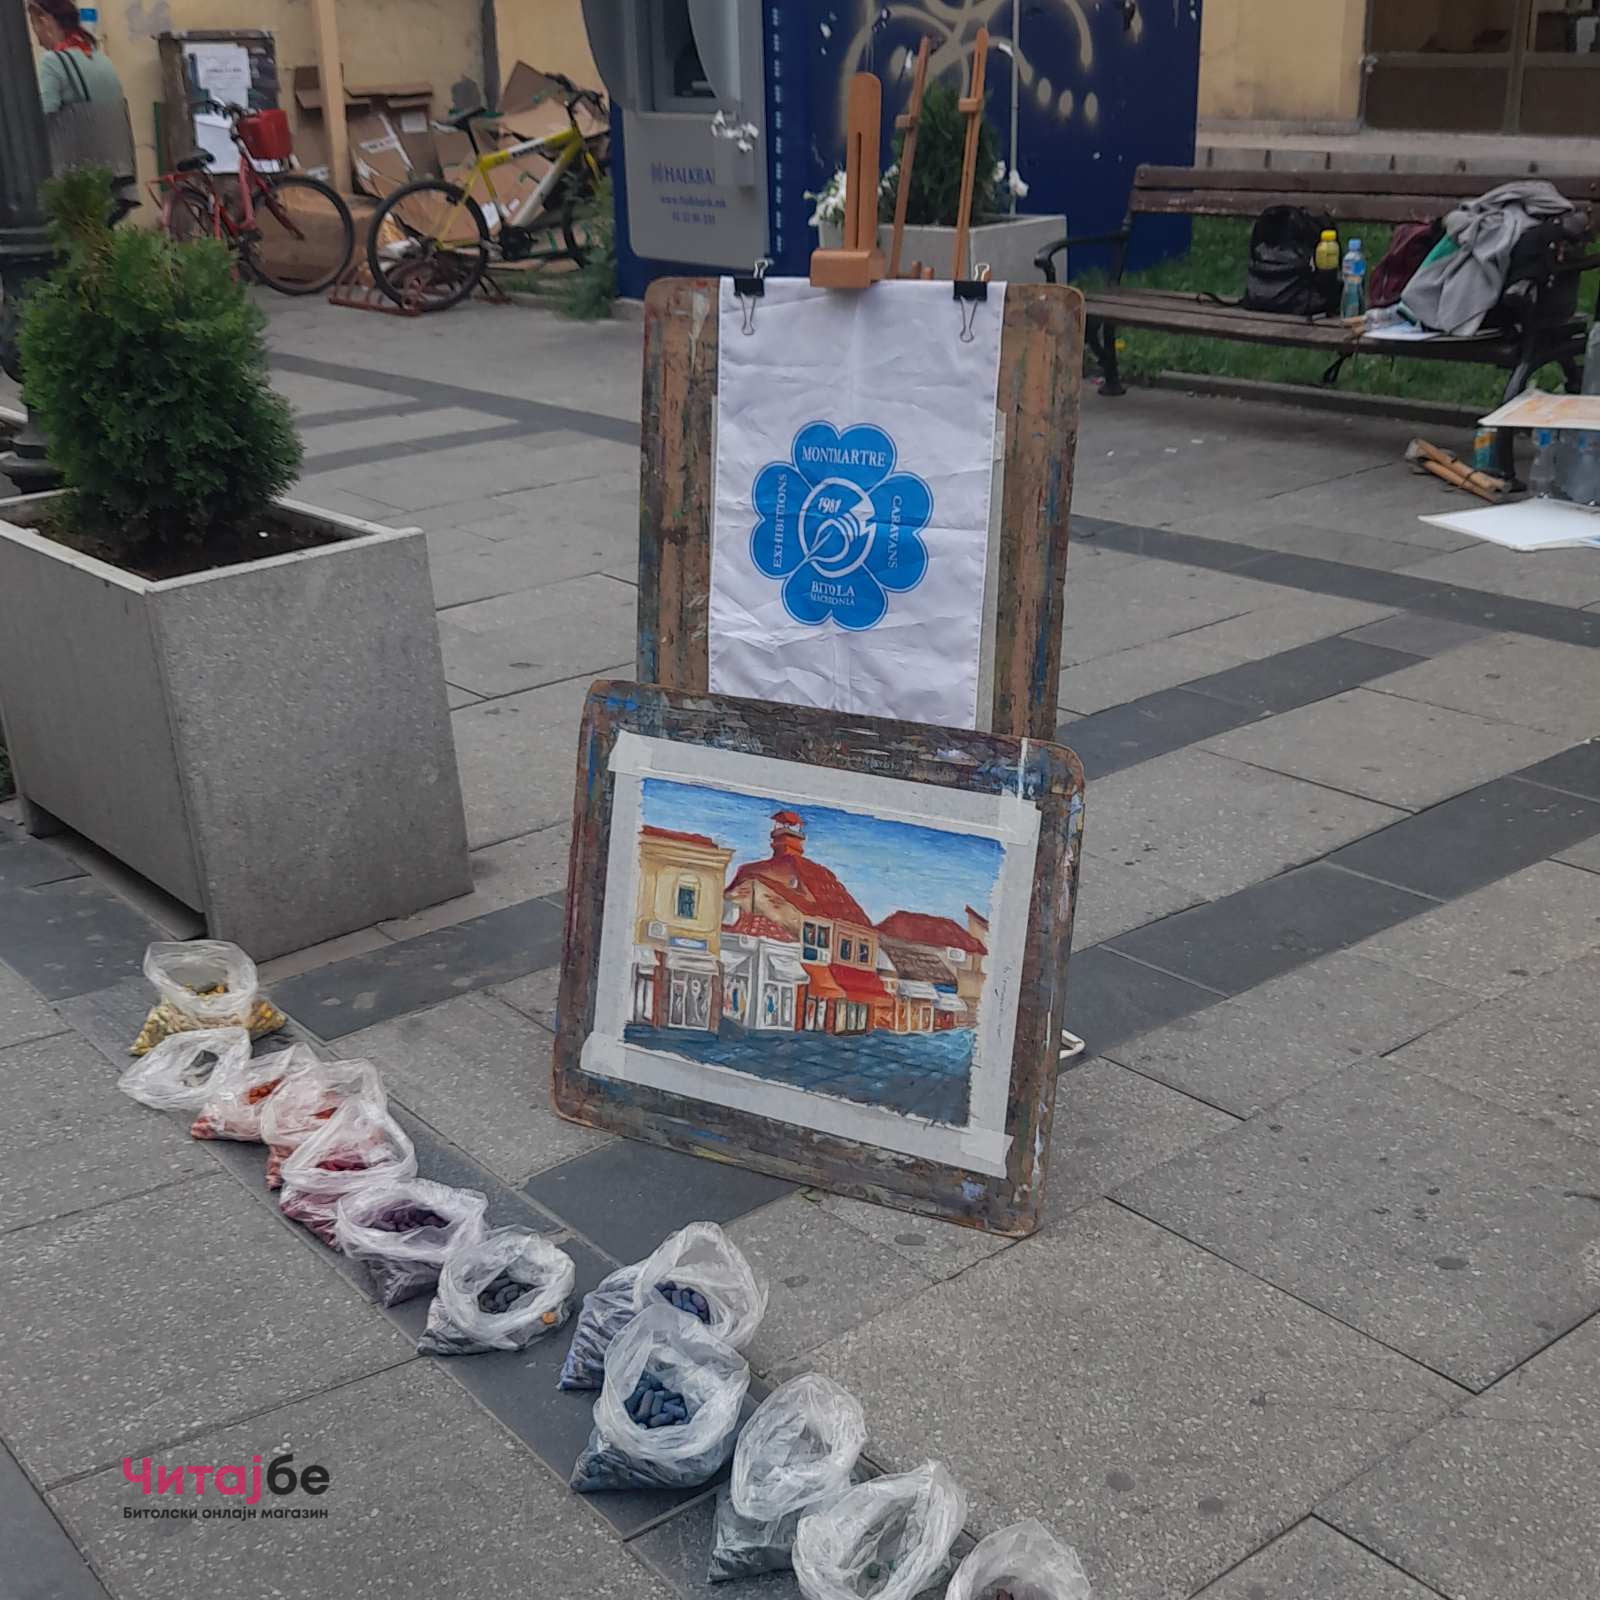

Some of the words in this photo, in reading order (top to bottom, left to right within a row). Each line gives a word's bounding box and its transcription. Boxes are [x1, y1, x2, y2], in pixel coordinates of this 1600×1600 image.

[802, 446, 887, 468] MONTMARTRE
[772, 473, 788, 569] EXHIBITIONS
[887, 495, 903, 569] CARAVANS
[811, 580, 856, 597] BITOLA
